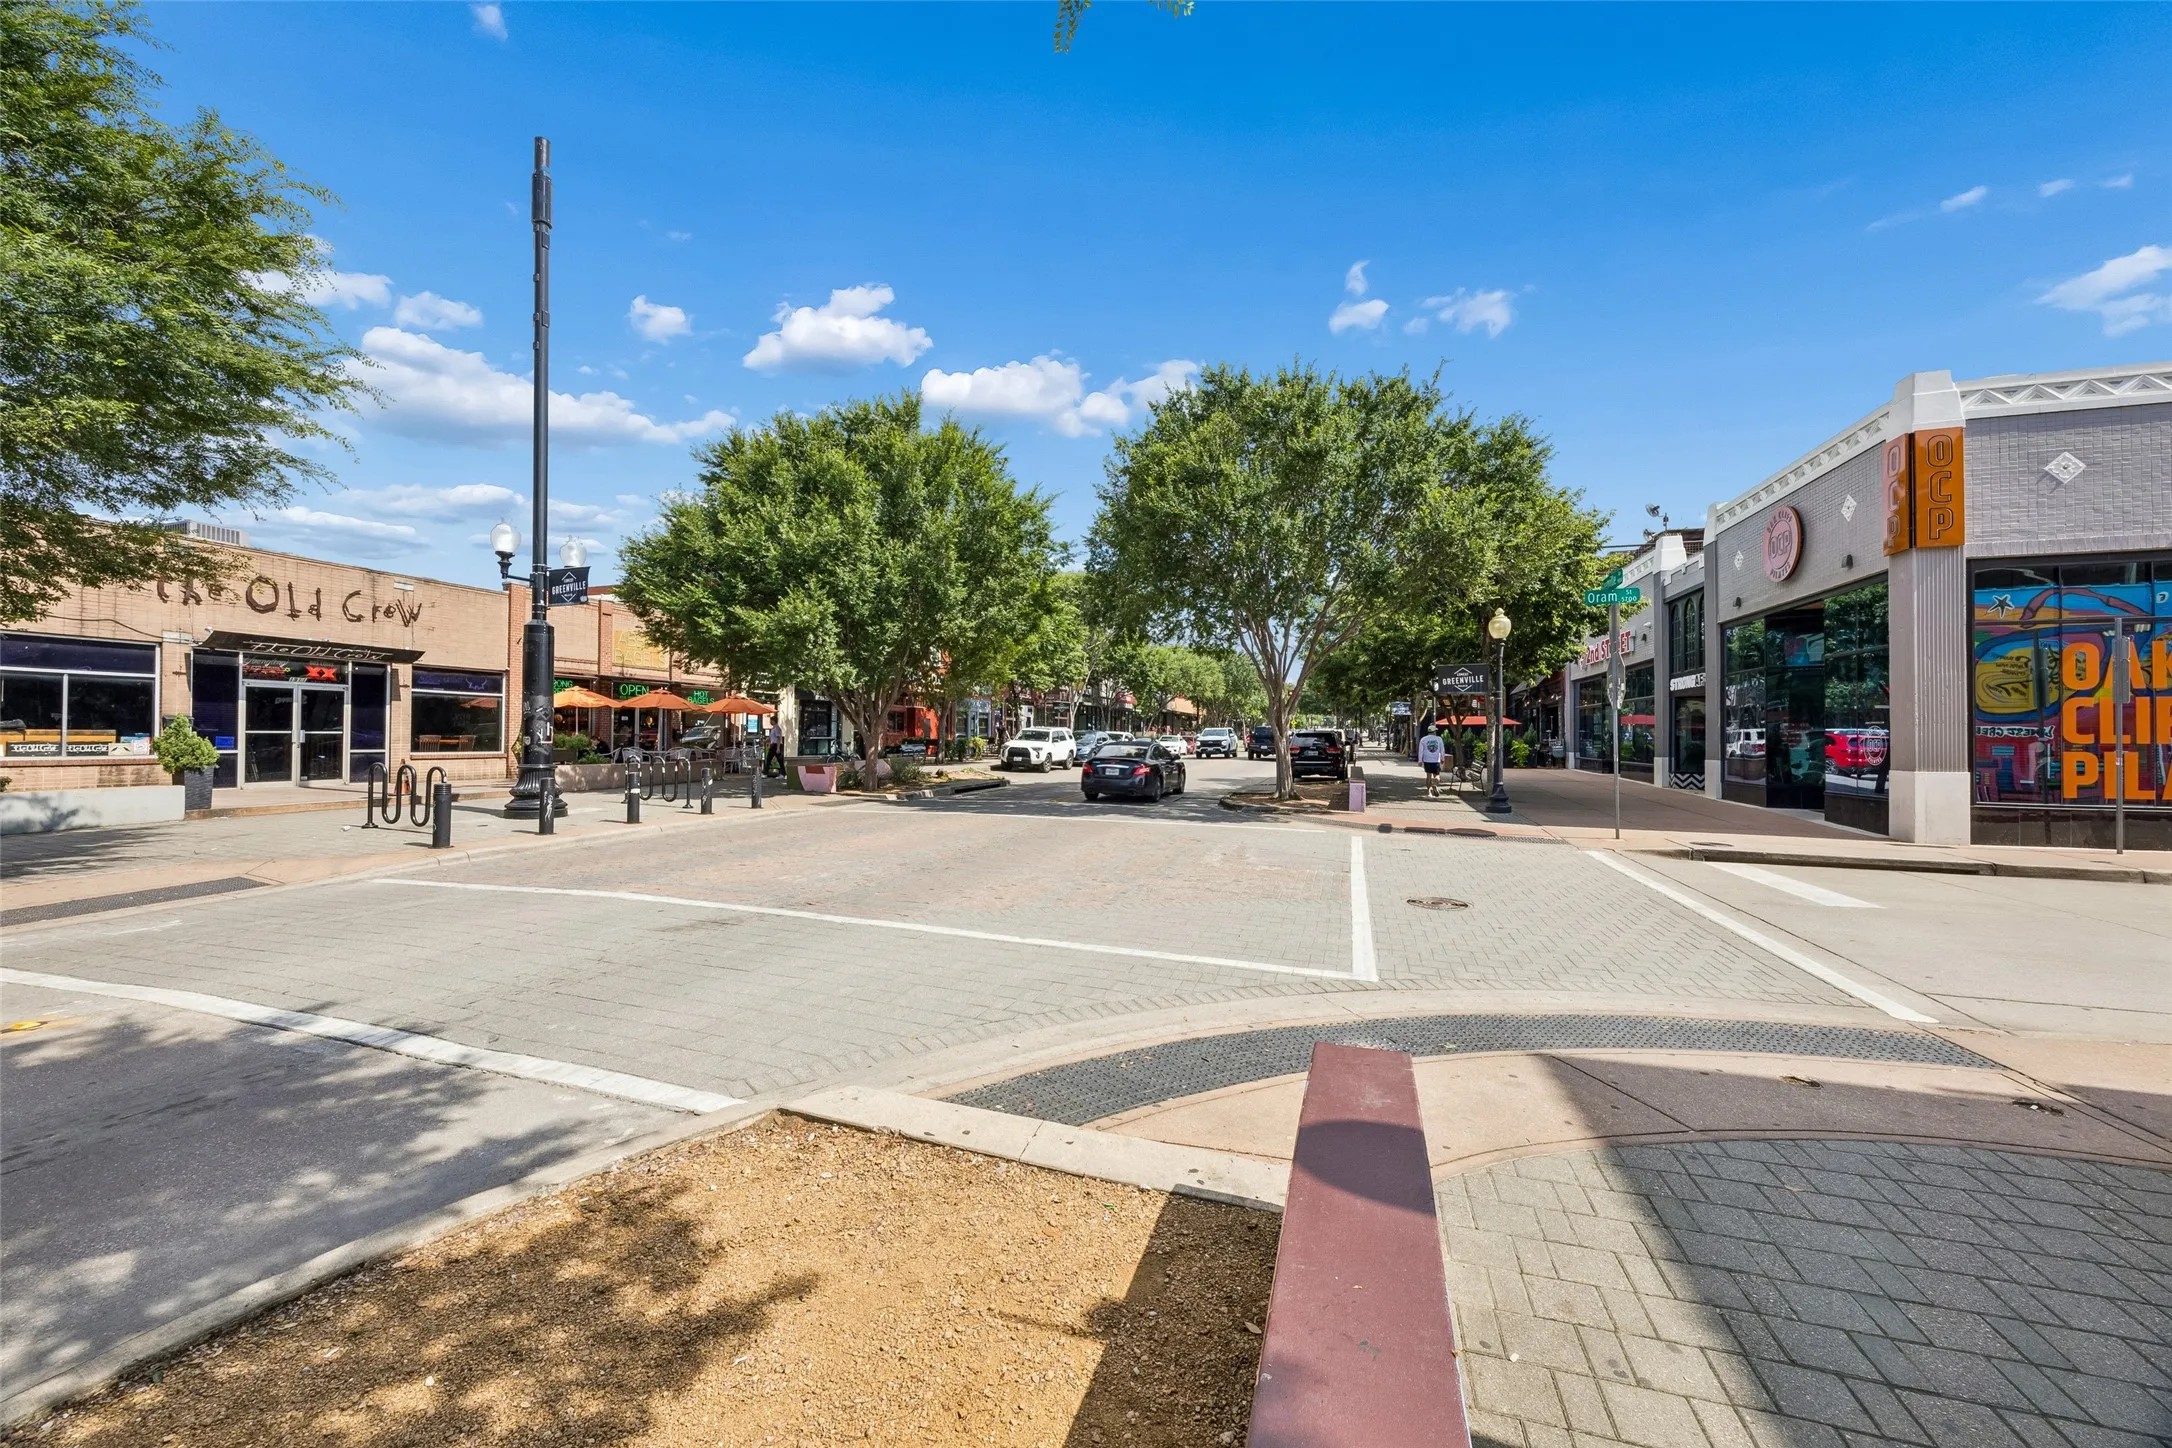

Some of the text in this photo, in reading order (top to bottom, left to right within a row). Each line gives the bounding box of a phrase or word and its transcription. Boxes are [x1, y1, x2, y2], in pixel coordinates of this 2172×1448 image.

[1927, 434, 1954, 540] OCP
[1887, 444, 1901, 548] OCP
[1768, 530, 1791, 559] OCP
[551, 580, 586, 595] GREENVILLE
[245, 575, 322, 622] Old
[1587, 588, 1633, 604] Oram St
[614, 648, 666, 669] BAGELS
[1442, 675, 1484, 686] GREENVILLE
[619, 683, 649, 697] OPEN
[693, 690, 710, 698] HOT
[687, 696, 715, 704] BAGELS
